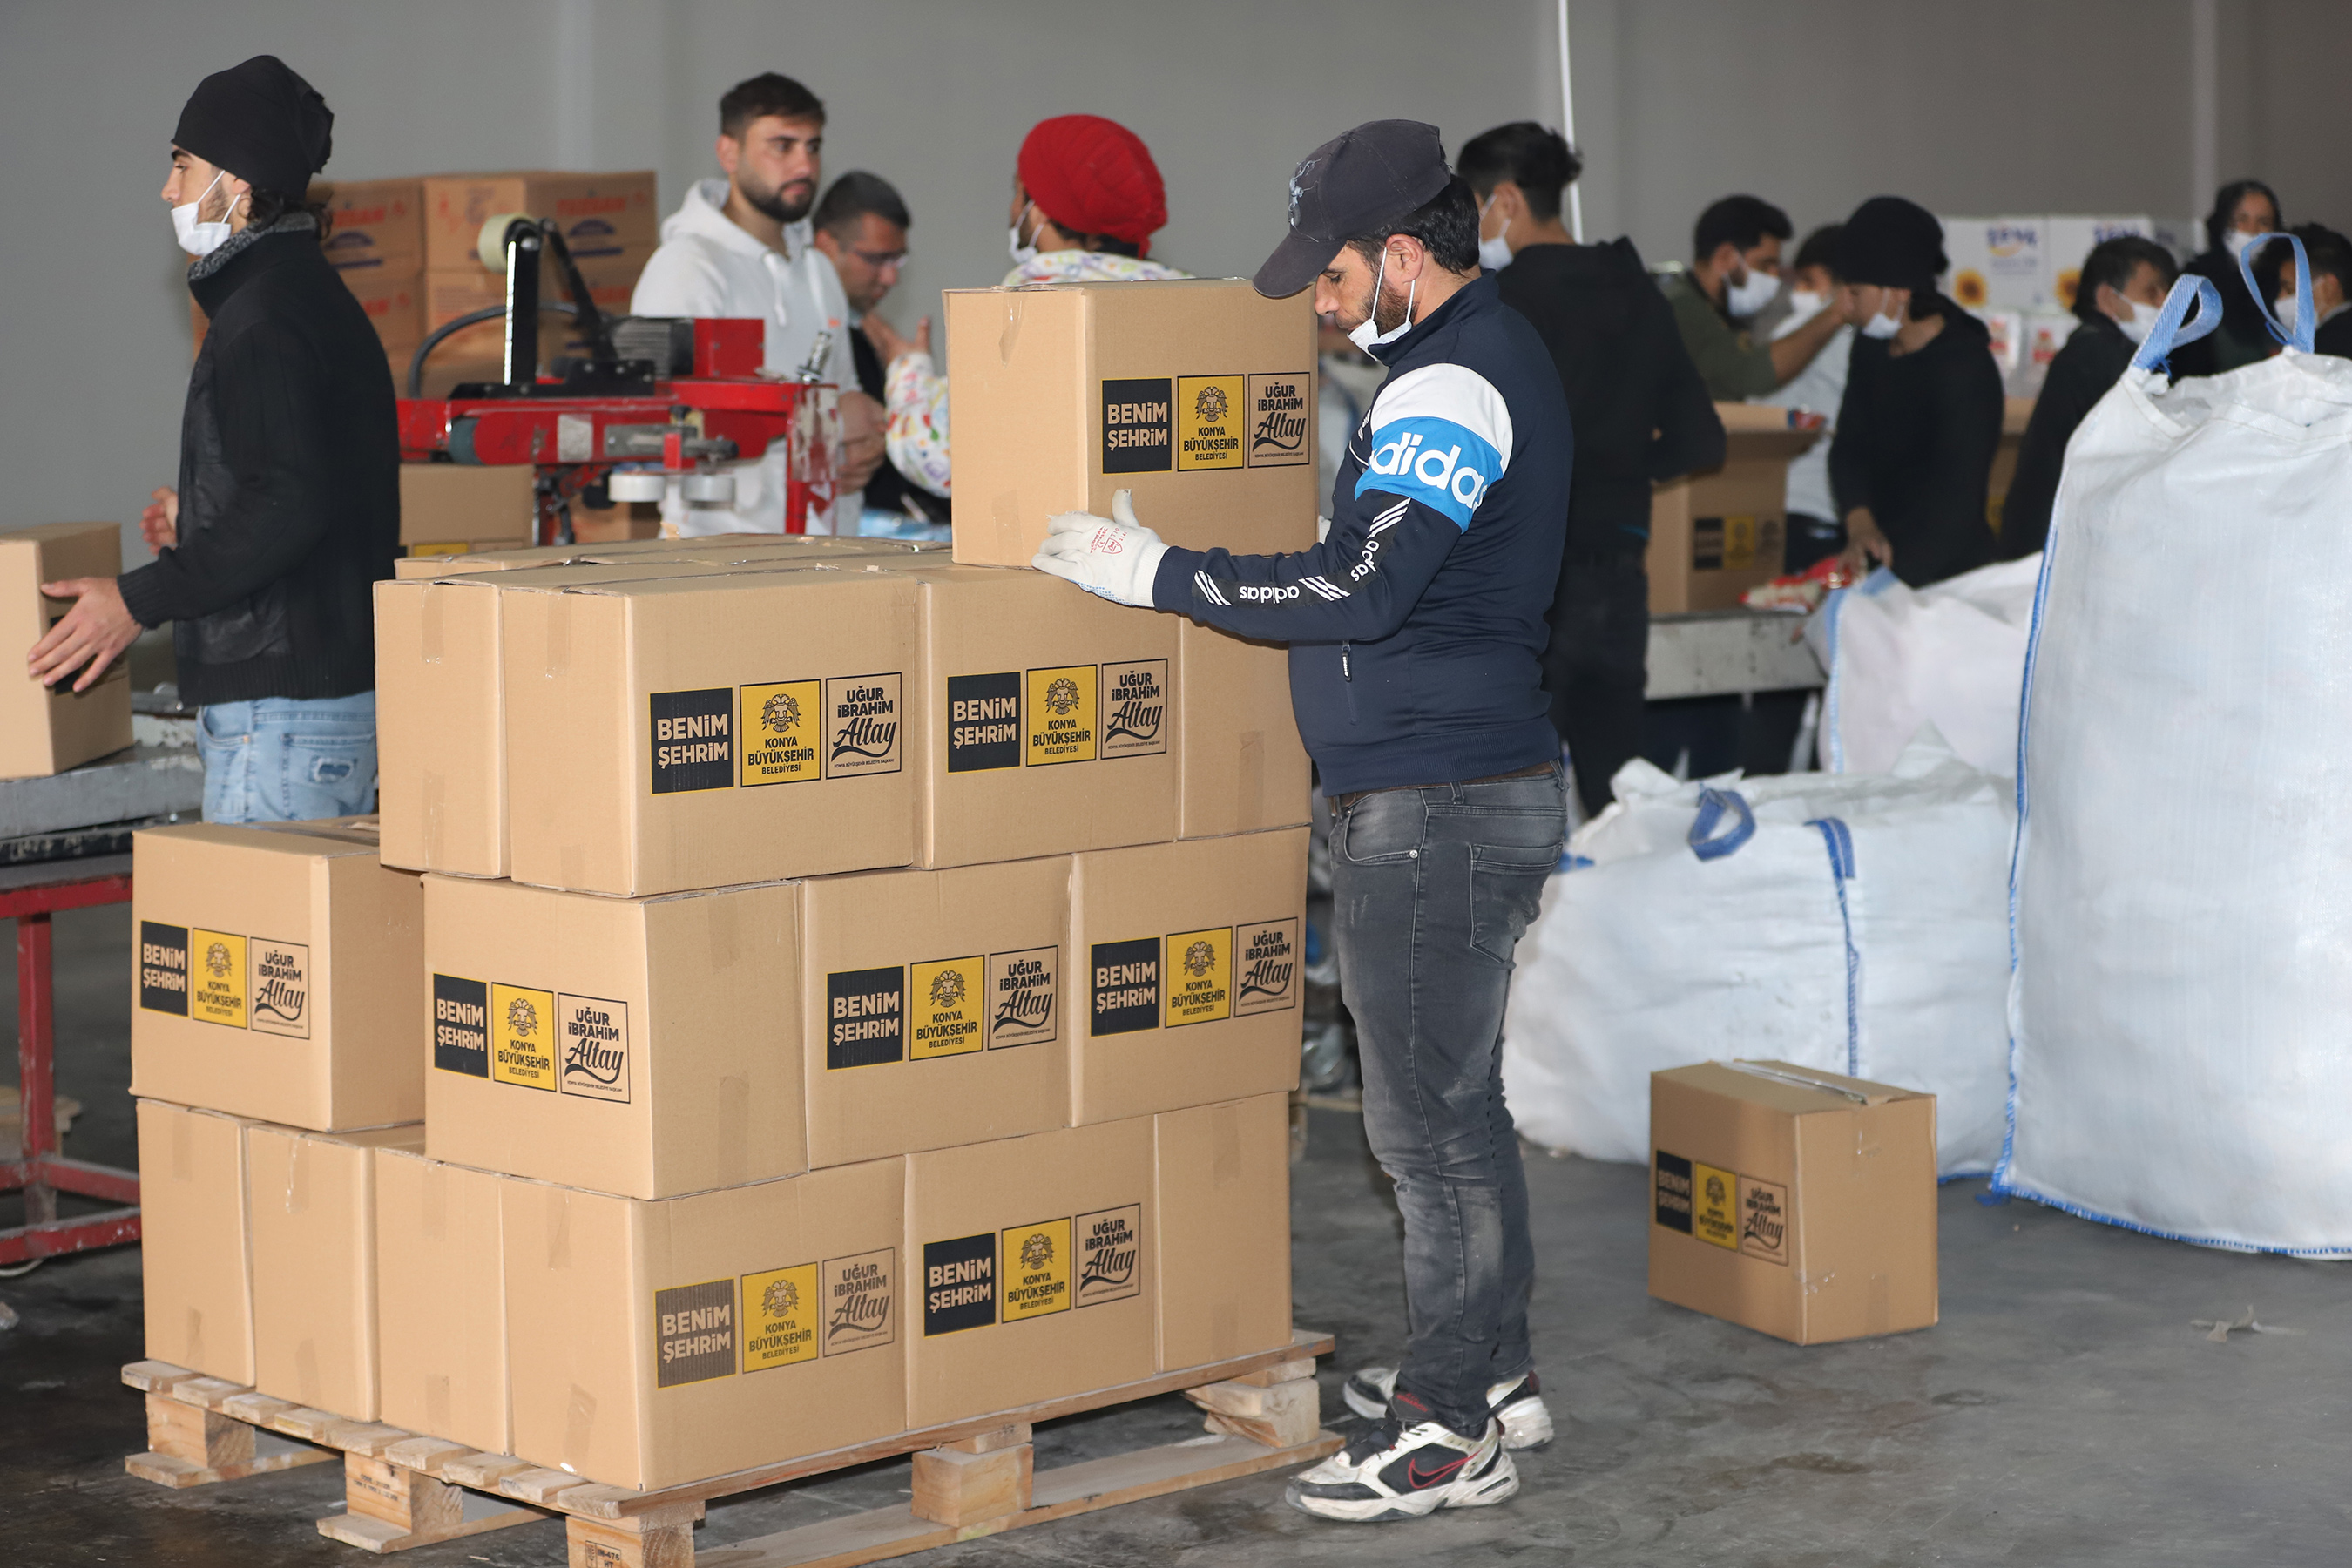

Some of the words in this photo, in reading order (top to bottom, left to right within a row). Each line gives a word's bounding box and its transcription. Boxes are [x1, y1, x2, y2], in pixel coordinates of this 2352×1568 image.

[1266, 382, 1295, 397] UĞUR
[1199, 427, 1225, 436] KONYA
[1253, 412, 1306, 451] Altay
[1119, 671, 1152, 687] UĞUR
[847, 686, 884, 703] UĞUR
[1048, 719, 1077, 730] KONYA
[1105, 700, 1163, 743] Altay
[765, 737, 798, 748] KONYA
[831, 717, 896, 762] Altay
[1253, 931, 1283, 947] UĞUR
[1008, 960, 1042, 977] UĞUR
[208, 981, 230, 993] KONYA
[1186, 980, 1213, 992] KONYA
[1240, 960, 1293, 1001] Altay
[254, 979, 305, 1021] Altay
[932, 1010, 963, 1023] KONYA
[993, 990, 1052, 1034] Altay
[510, 1039, 536, 1053] KONYA
[564, 1038, 624, 1084] Altay
[1080, 1248, 1136, 1292] Altay
[1023, 1273, 1051, 1285] KONYA
[828, 1294, 889, 1340] Altay
[765, 1320, 796, 1334] KONYA
